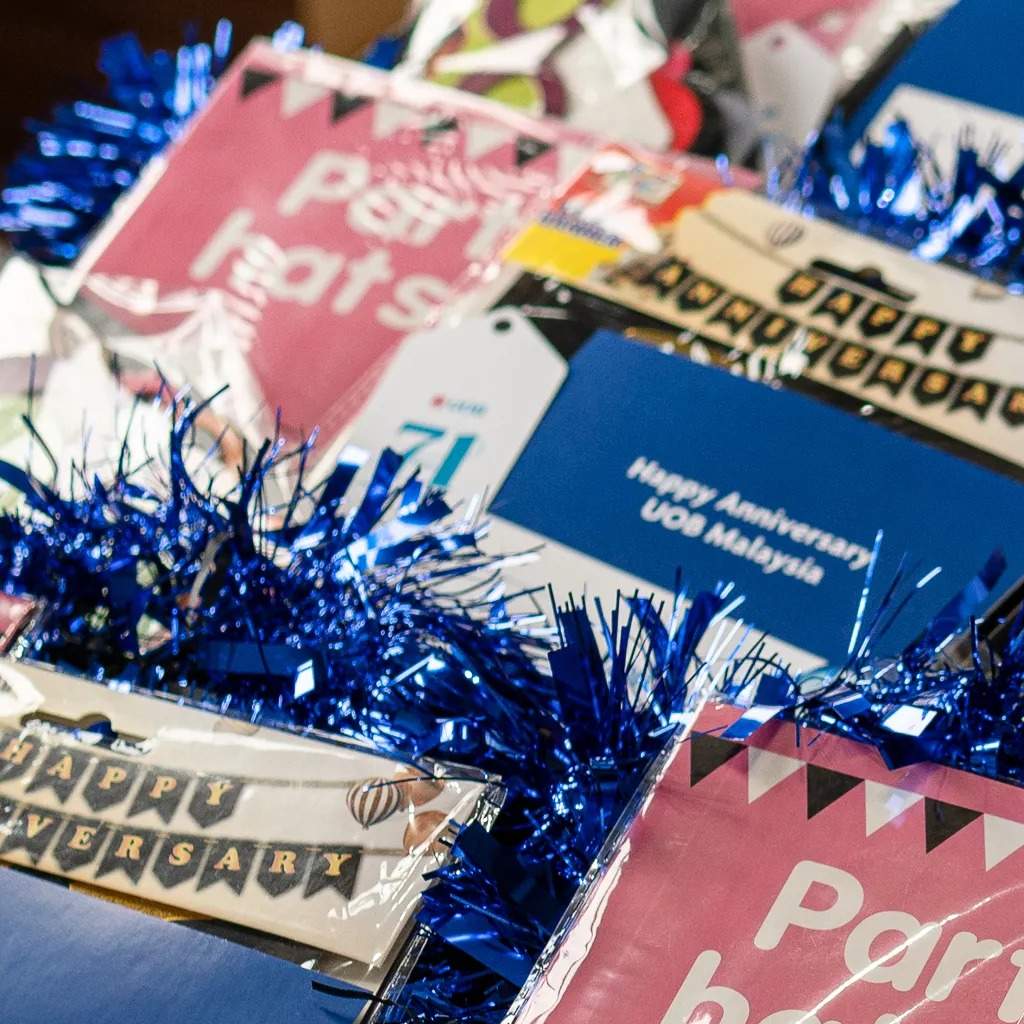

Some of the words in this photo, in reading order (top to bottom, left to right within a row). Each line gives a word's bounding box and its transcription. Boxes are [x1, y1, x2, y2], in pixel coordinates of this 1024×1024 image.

[626, 456, 718, 509] Happy
[714, 491, 872, 571] Anniversary
[640, 496, 707, 537] UOB
[703, 522, 825, 586] Malaysia
